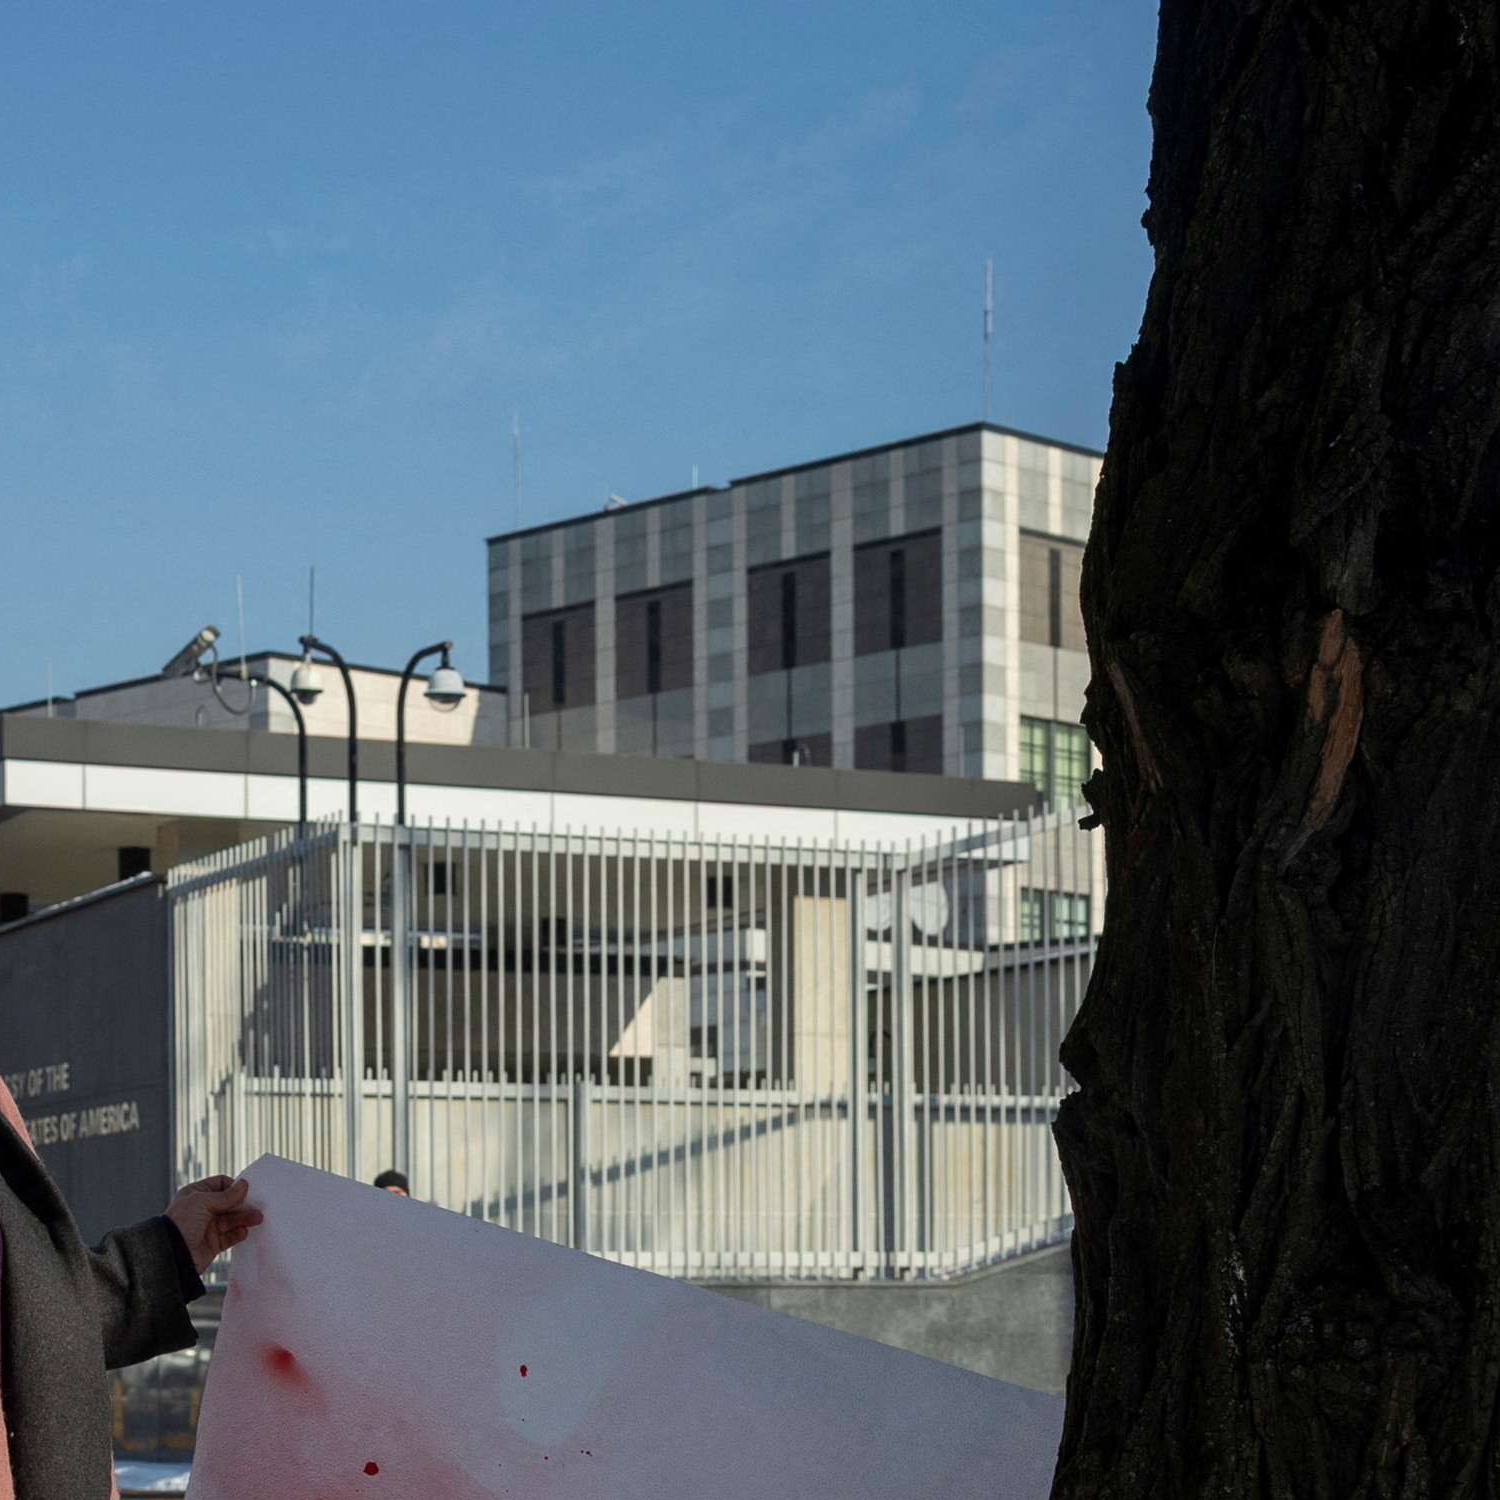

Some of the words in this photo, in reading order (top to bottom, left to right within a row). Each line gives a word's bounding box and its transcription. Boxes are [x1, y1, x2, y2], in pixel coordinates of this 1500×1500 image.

[27, 1068, 44, 1097] OF
[45, 1061, 70, 1094] THE
[60, 1112, 77, 1141] OF
[78, 1101, 140, 1138] AMERICA
